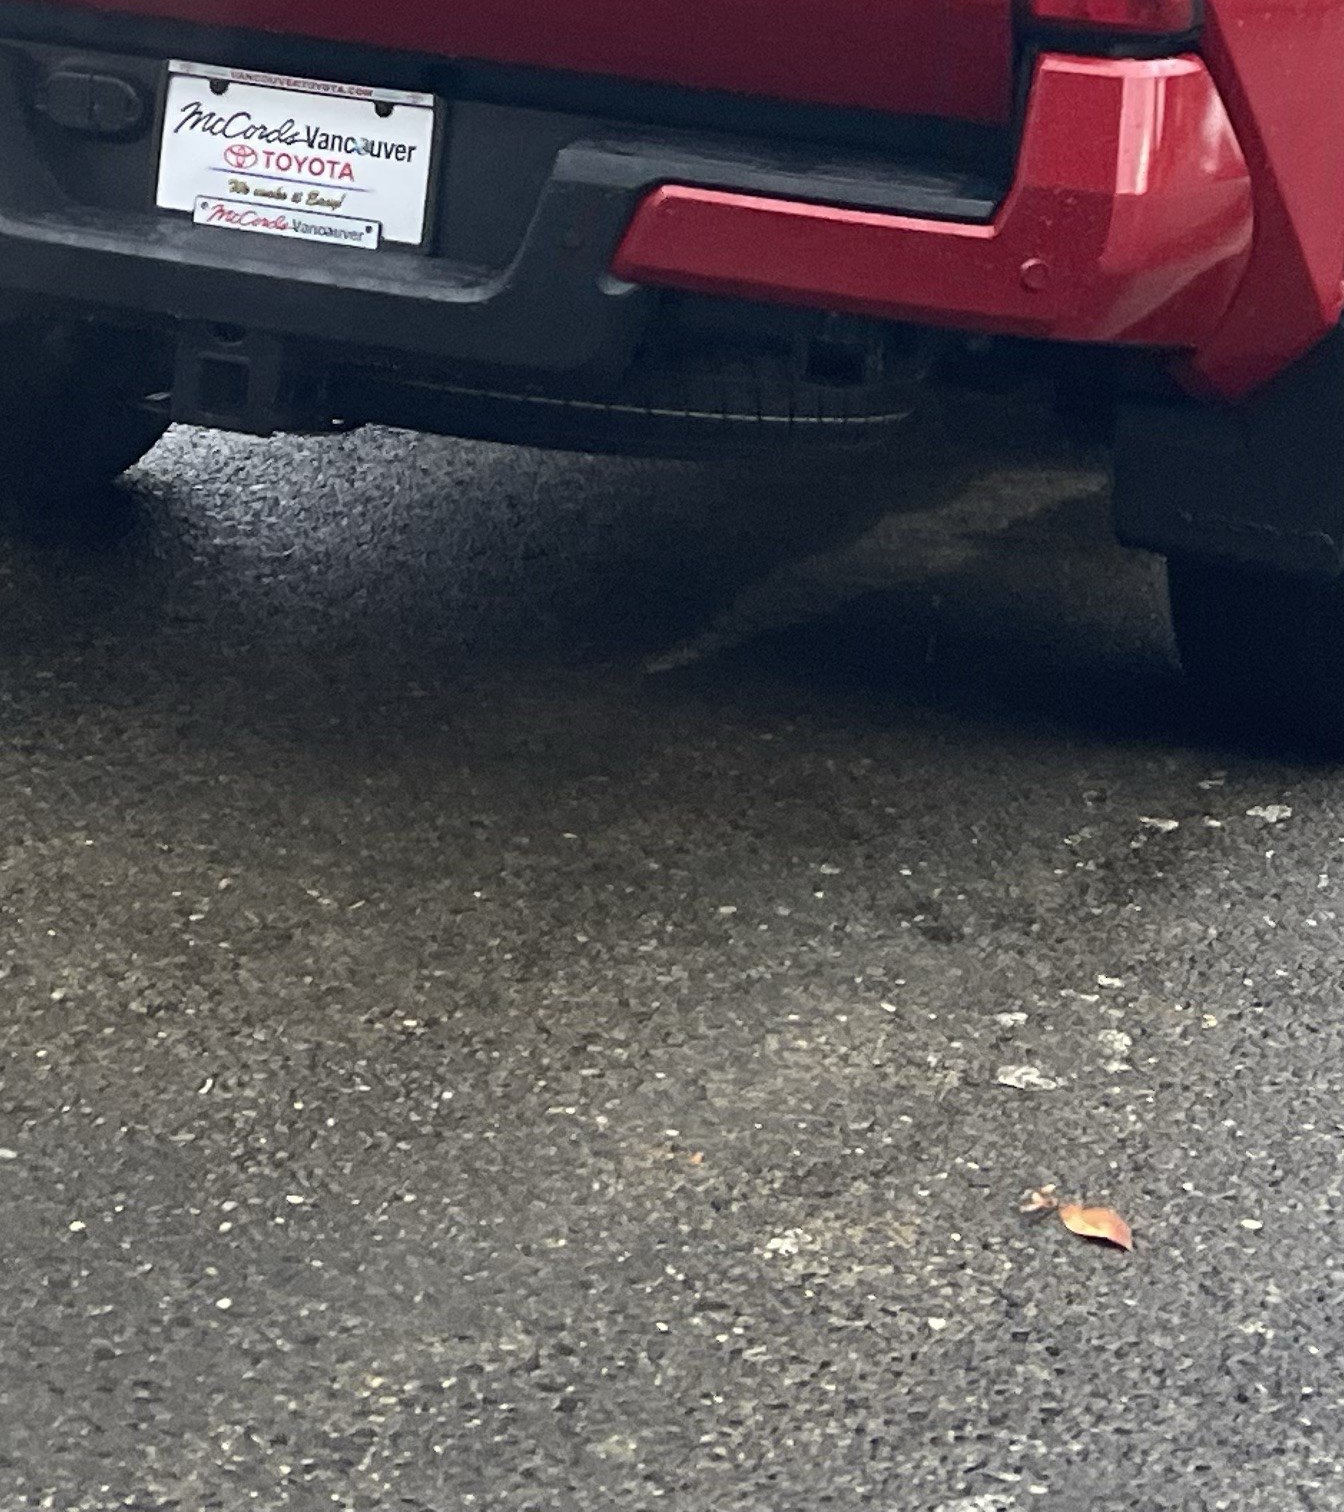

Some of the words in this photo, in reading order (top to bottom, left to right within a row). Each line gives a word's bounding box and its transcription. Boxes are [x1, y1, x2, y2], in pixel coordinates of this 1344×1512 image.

[173, 101, 307, 146] McCords
[305, 125, 416, 163] Vancouver
[262, 150, 354, 181] TOYOTA
